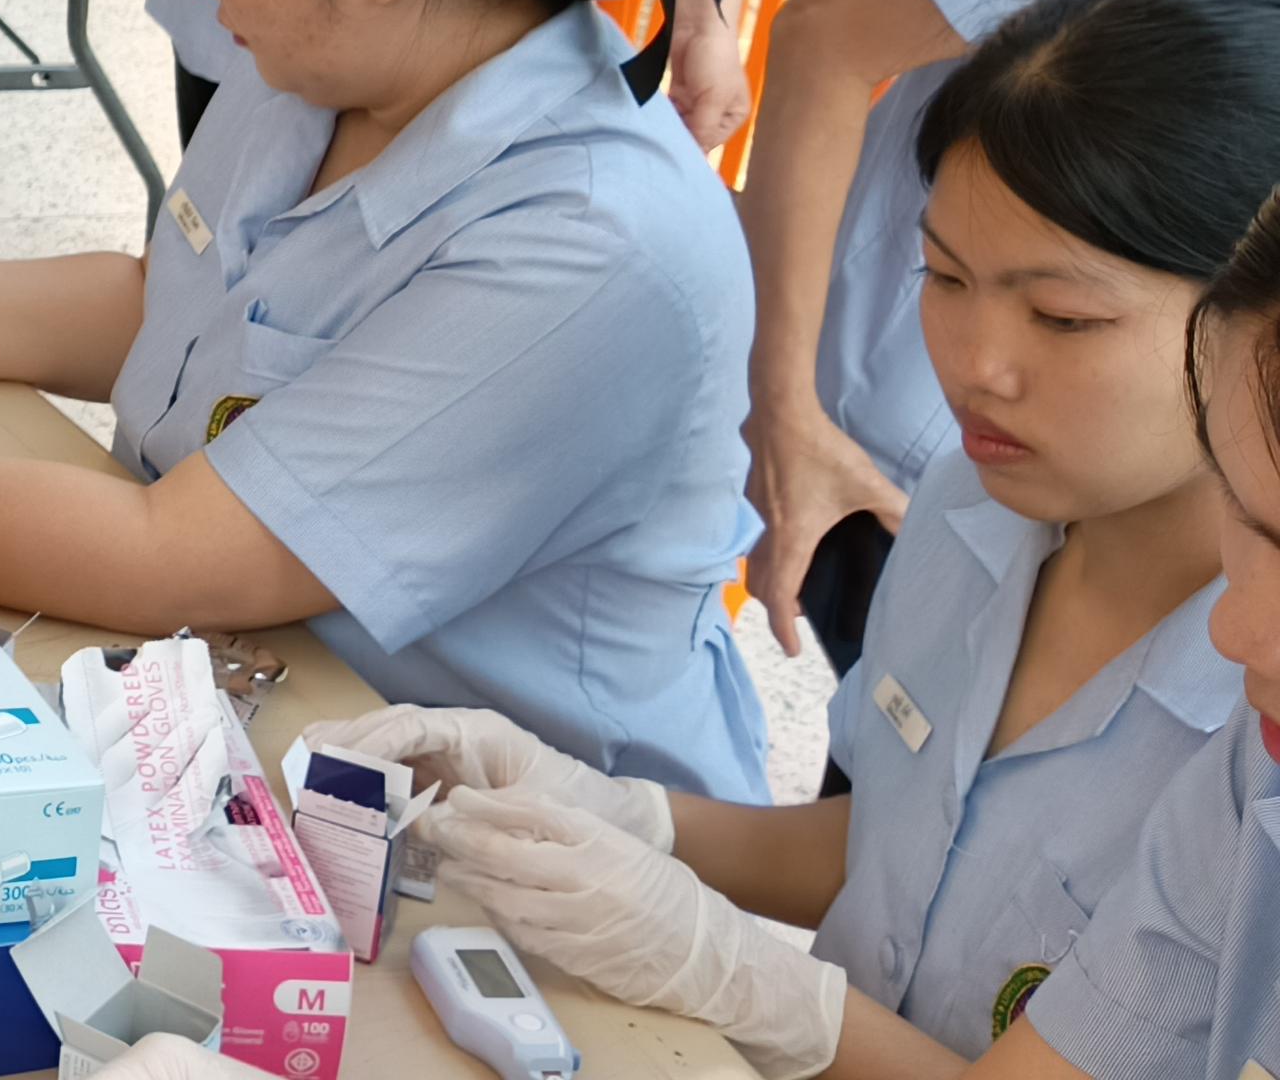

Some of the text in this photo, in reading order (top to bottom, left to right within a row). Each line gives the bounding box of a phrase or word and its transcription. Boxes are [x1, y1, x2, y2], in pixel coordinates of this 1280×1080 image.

[142, 661, 173, 737] GLOVES
[121, 662, 177, 871] LATEX POWDERED
[297, 988, 326, 1012] M
